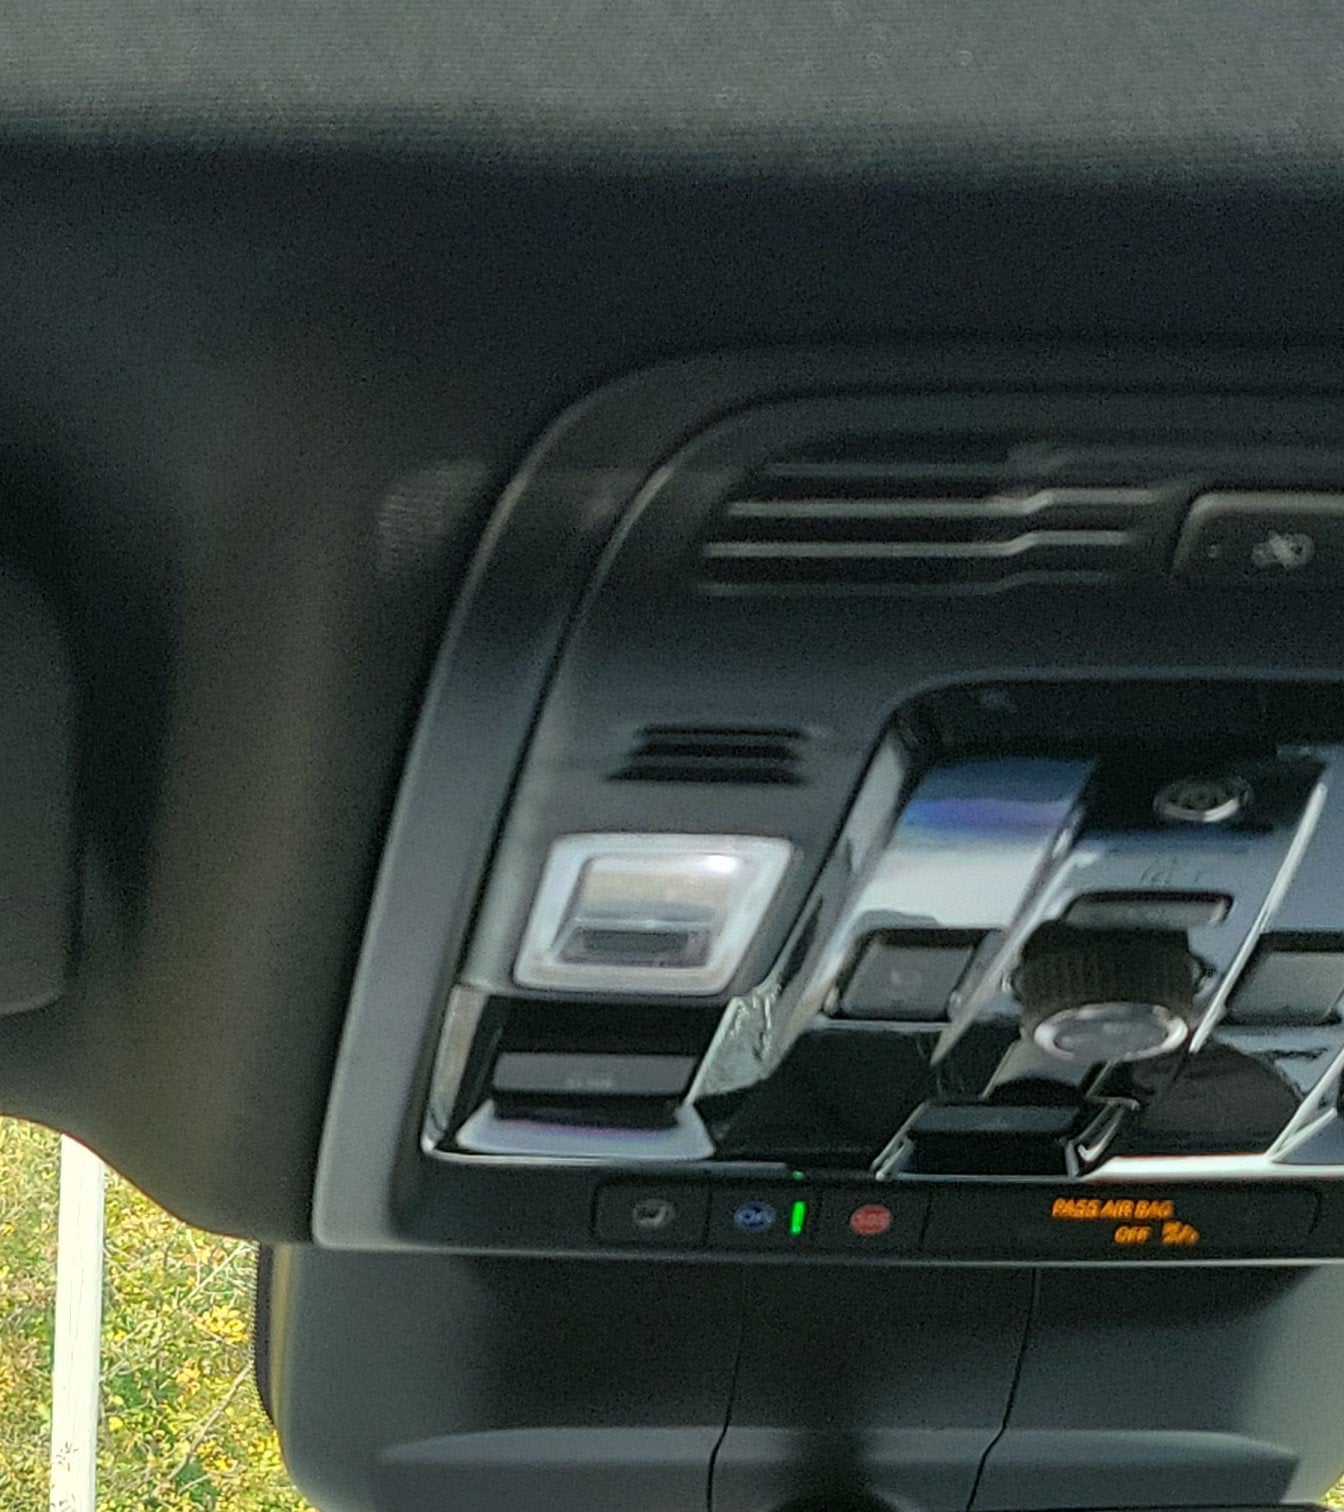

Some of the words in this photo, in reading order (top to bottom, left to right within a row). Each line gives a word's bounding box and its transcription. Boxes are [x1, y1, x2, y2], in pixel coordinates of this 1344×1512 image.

[1052, 1198, 1100, 1218] PASS
[1100, 1199, 1135, 1218] AIR
[1134, 1200, 1174, 1219] BAG
[1114, 1226, 1151, 1244] OFF
